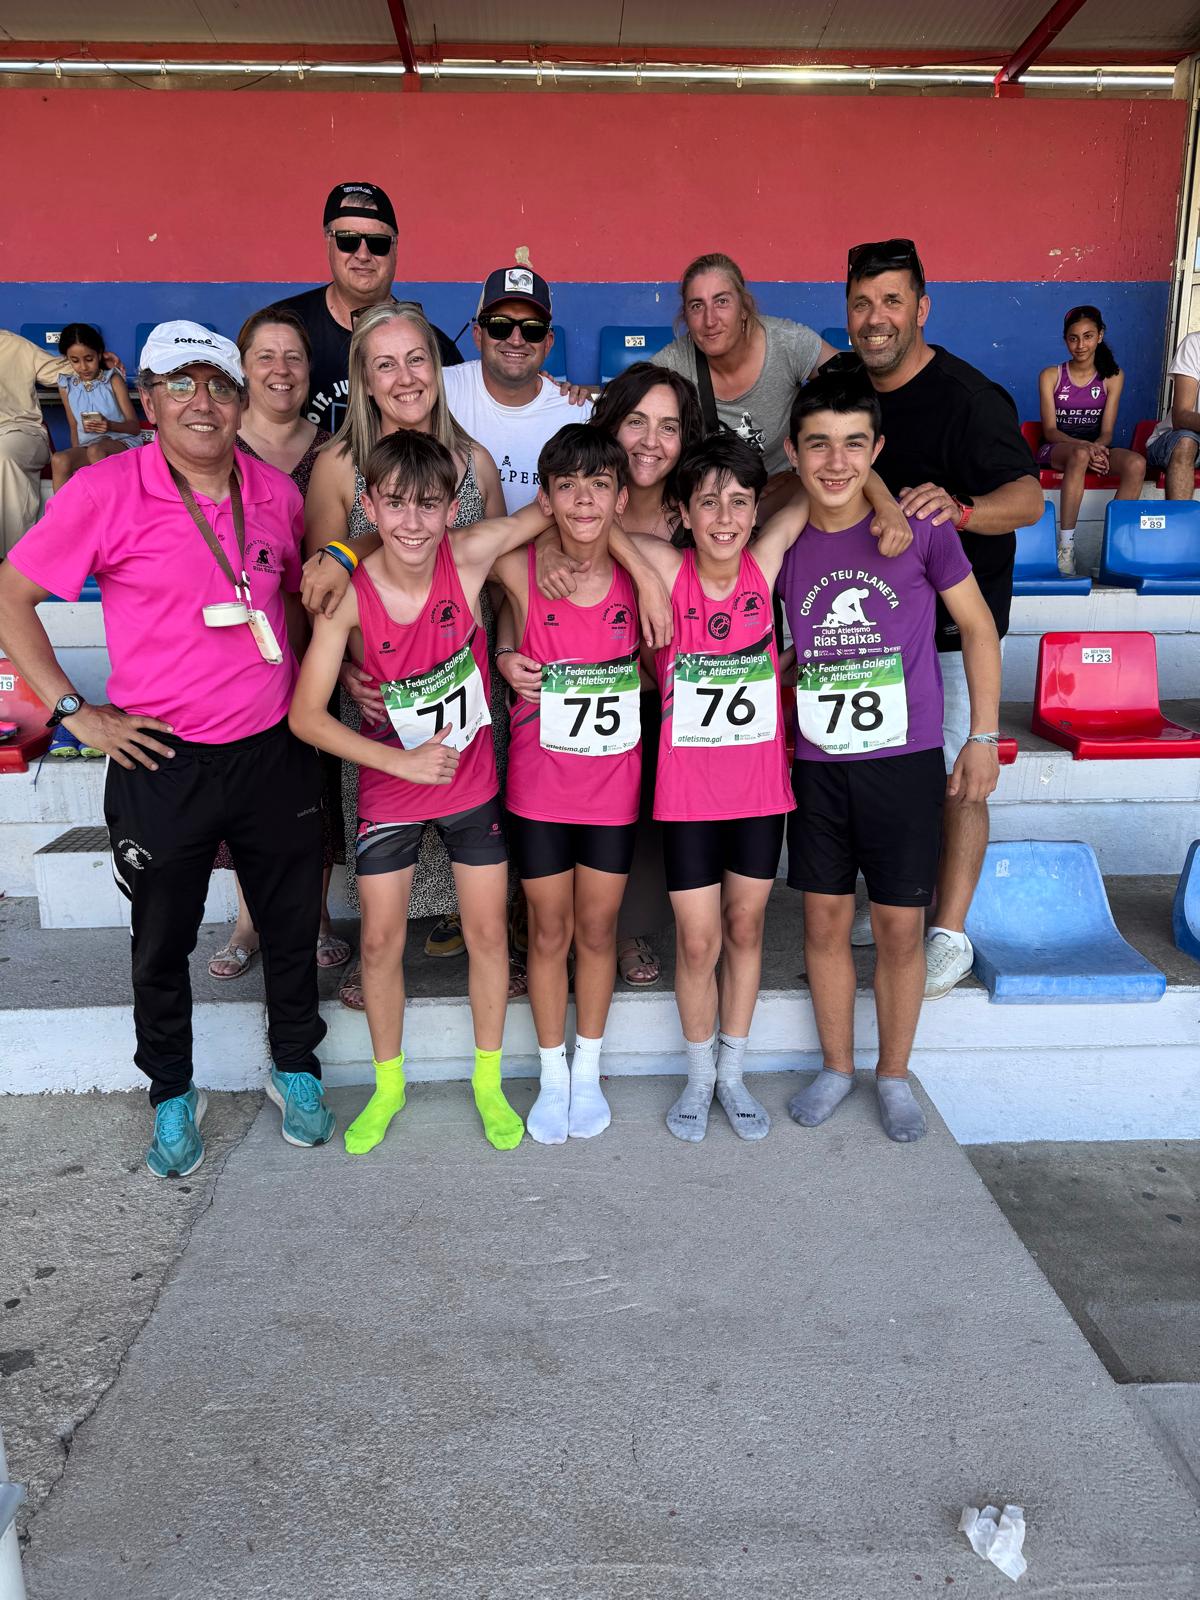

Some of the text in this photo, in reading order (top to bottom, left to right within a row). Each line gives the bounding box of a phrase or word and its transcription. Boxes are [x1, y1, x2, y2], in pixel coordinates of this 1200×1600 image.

[312, 392, 332, 412] IT.
[800, 570, 899, 616] COIDA O TEU PLANETA
[814, 633, 881, 646] Rías Baixas
[699, 655, 767, 666] Federación Galega
[1090, 654, 1111, 662] 123
[565, 665, 633, 676] Federación Galega
[709, 667, 748, 676] Atletismo
[819, 658, 896, 672] Federación Galega
[406, 668, 445, 689] Federación
[576, 676, 616, 685] Atletismo
[830, 671, 872, 682] Atletismo
[410, 671, 456, 698] de Atletismo
[416, 685, 466, 736] 77
[696, 686, 756, 726] 76
[818, 691, 884, 734] 78
[564, 696, 620, 737] 75
[678, 736, 722, 744] atletismo.gal
[546, 744, 590, 753] atletismo.gal
